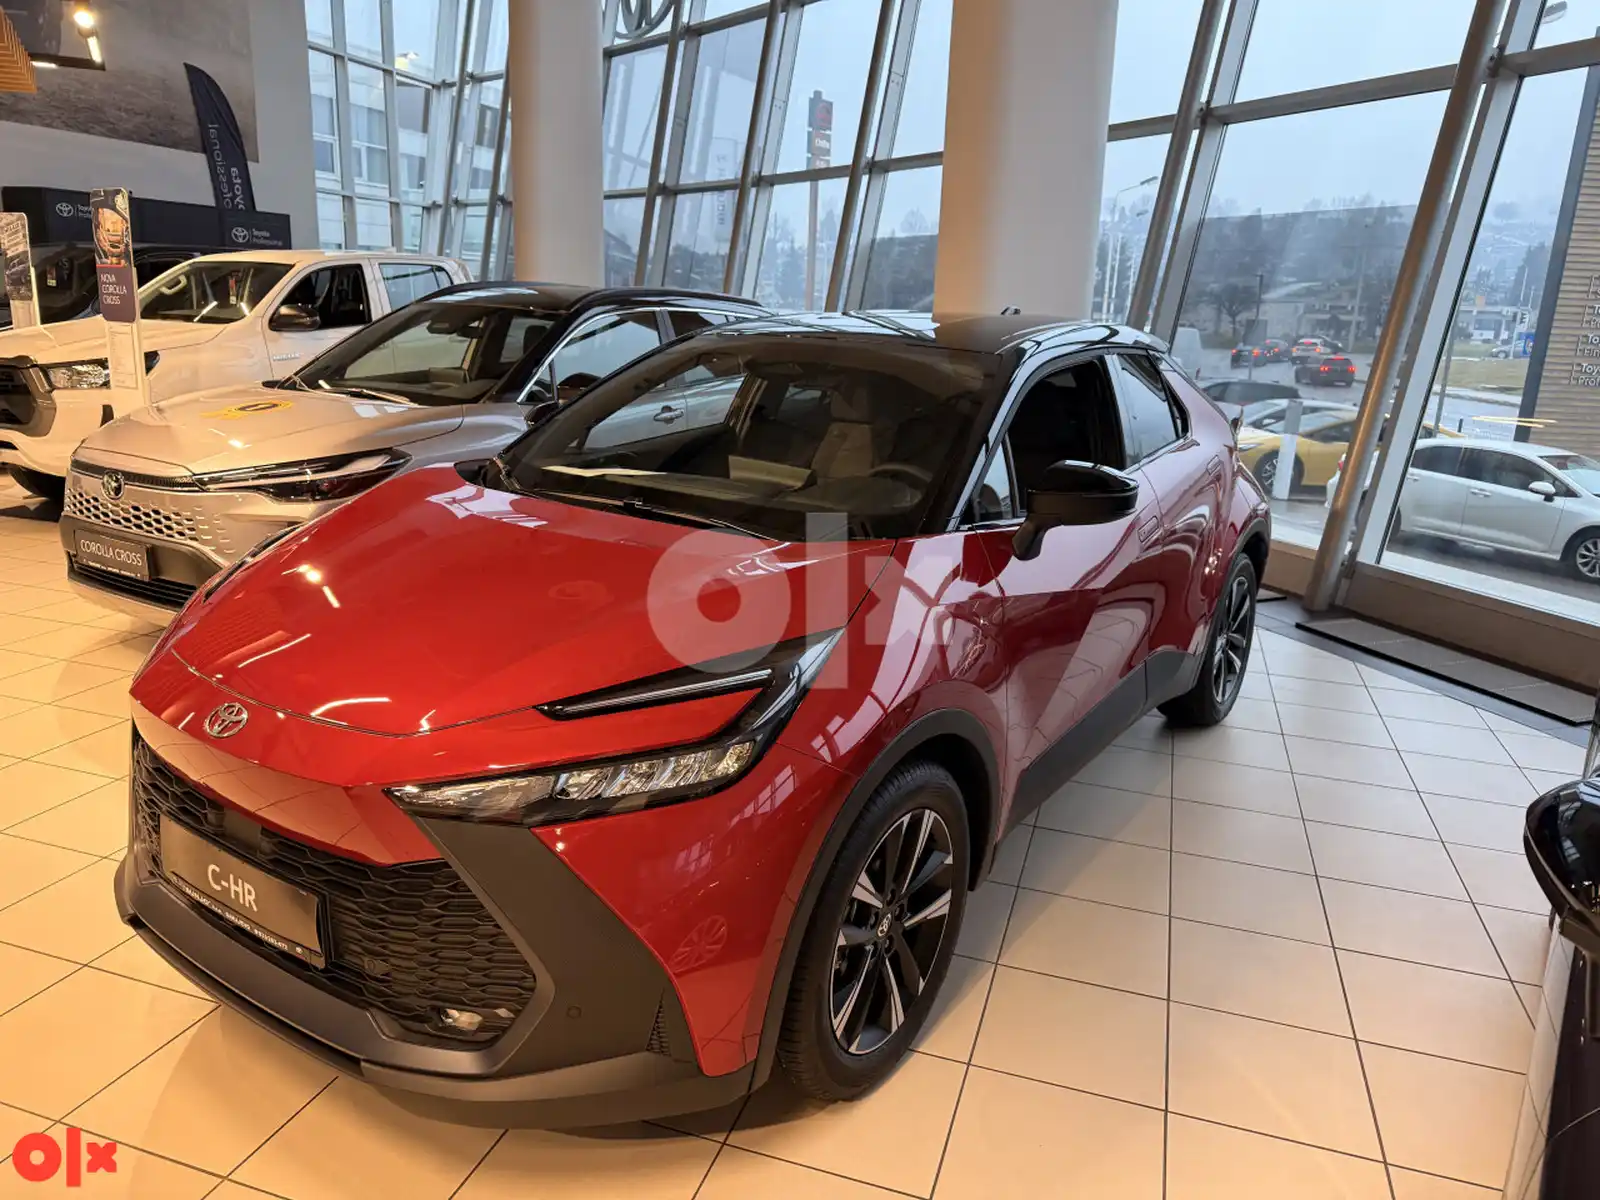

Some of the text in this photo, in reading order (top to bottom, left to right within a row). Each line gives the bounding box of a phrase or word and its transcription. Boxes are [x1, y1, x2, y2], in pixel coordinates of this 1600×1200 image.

[101, 273, 116, 283] NOVA
[102, 284, 127, 295] COROLLA
[103, 295, 121, 305] CROSS
[1581, 364, 1600, 376] Toy
[80, 539, 142, 566] COROLLA CROSS
[207, 864, 258, 912] C-HR
